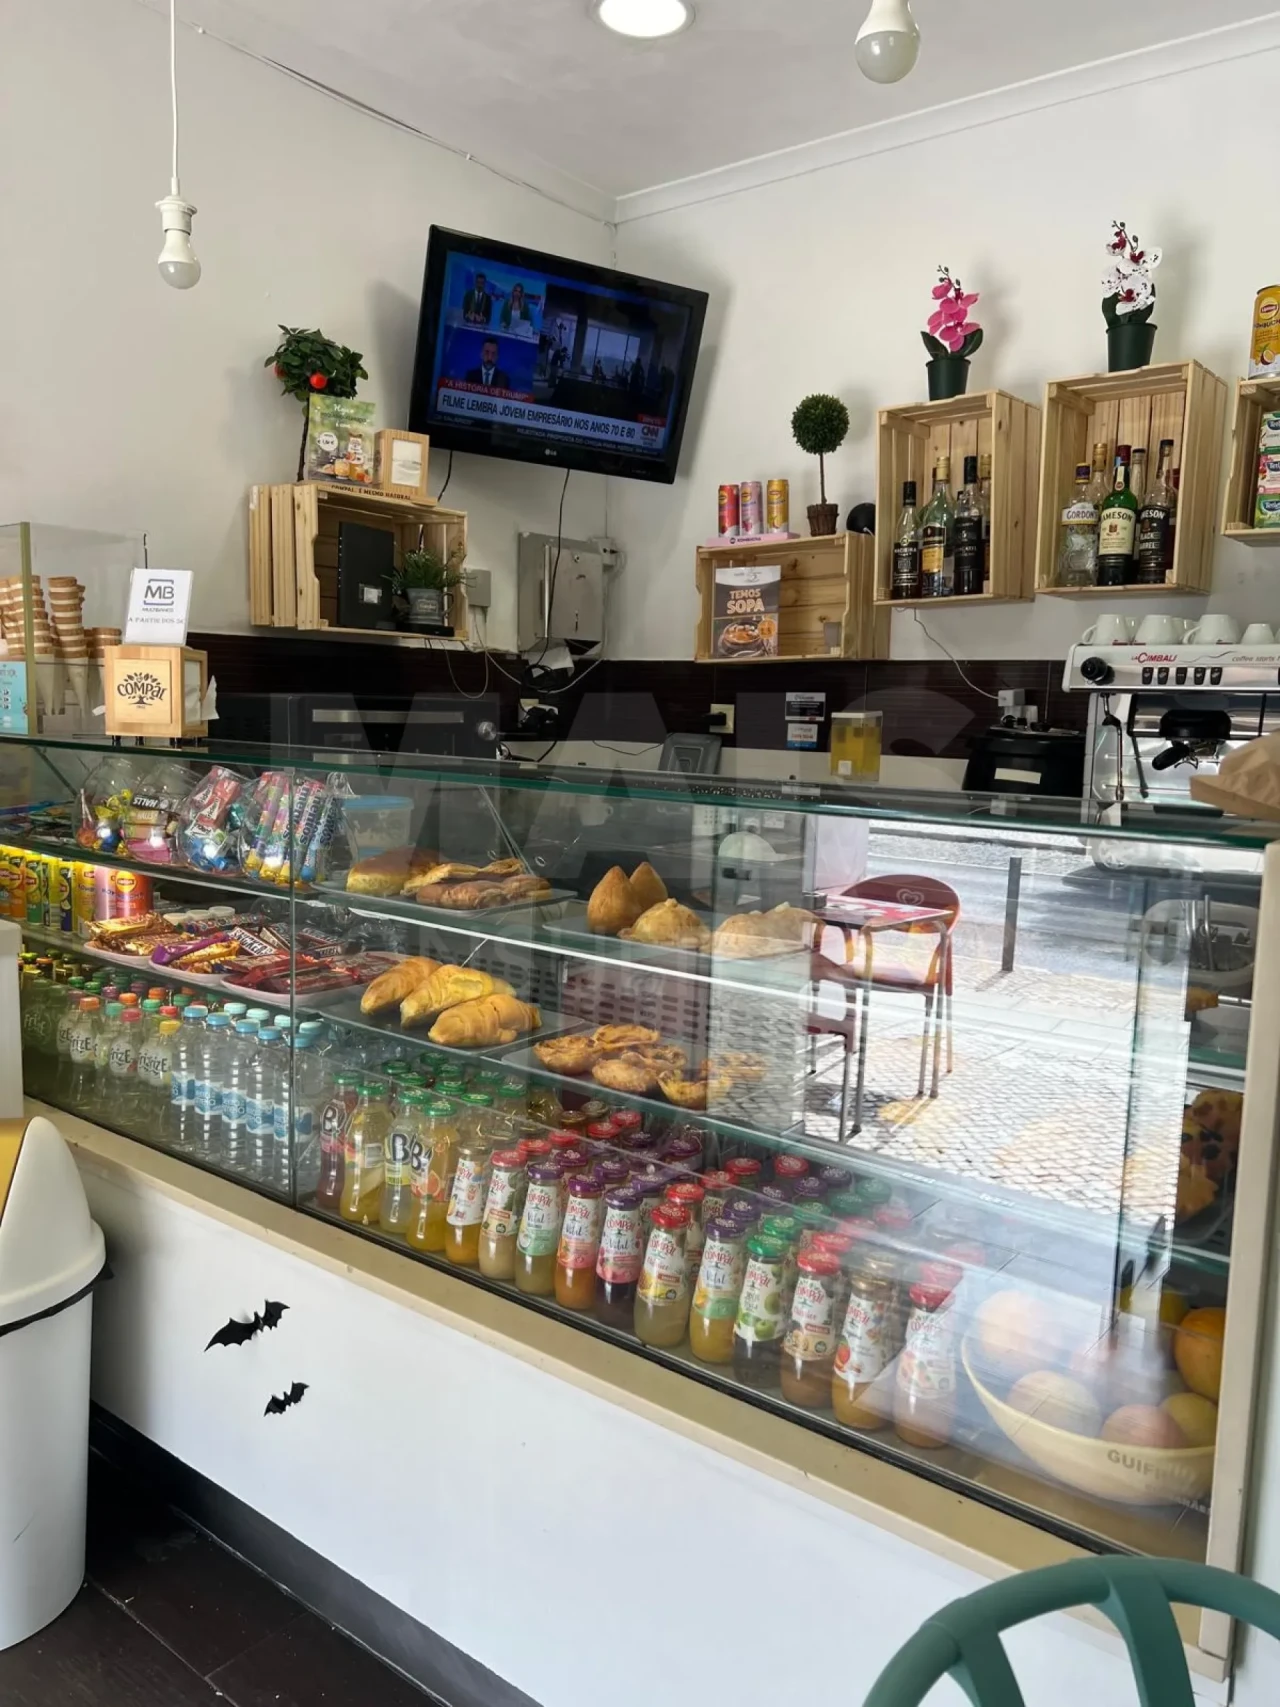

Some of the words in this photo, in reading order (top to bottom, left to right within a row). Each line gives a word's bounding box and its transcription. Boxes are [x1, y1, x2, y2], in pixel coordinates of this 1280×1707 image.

[442, 394, 465, 410] FILME
[467, 399, 498, 416] LEMBRA
[499, 404, 526, 421] JOVEM
[527, 409, 573, 428] EMPRESÁRIO
[574, 418, 589, 431] NOS
[589, 420, 610, 435] ANOS
[610, 423, 620, 436] 70
[620, 426, 626, 437] E
[626, 427, 636, 439] 80
[641, 426, 659, 438] CNN
[144, 585, 174, 600] MB
[729, 588, 761, 600] TEMOS
[726, 598, 765, 614] SOPA
[1138, 652, 1178, 663] CIMBALI
